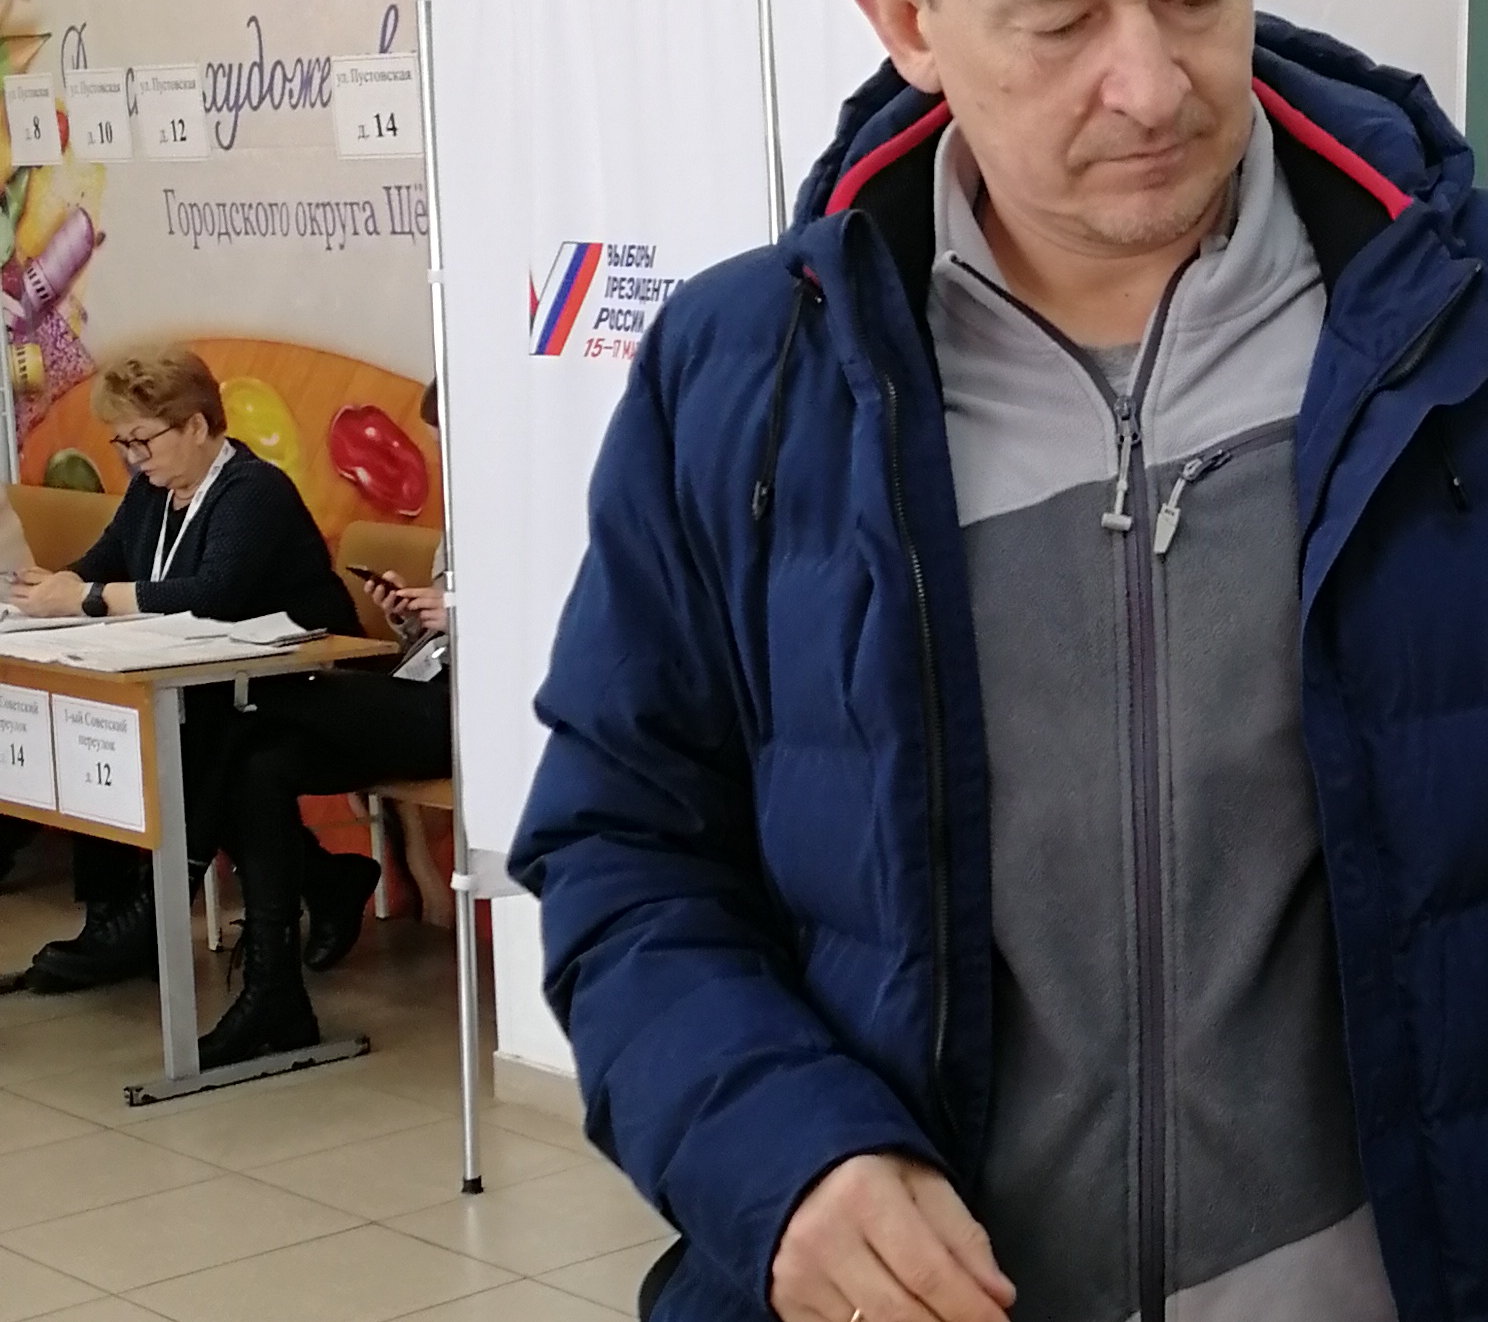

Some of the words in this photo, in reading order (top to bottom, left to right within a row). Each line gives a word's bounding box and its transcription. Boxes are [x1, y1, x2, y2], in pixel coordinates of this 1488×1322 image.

[33, 115, 42, 140] 8
[98, 121, 113, 144] 10
[170, 118, 188, 142] 12
[373, 112, 399, 137] 14
[163, 187, 291, 250] Городского
[294, 199, 382, 251] округа
[10, 742, 25, 768] 14
[96, 762, 113, 787] 12
